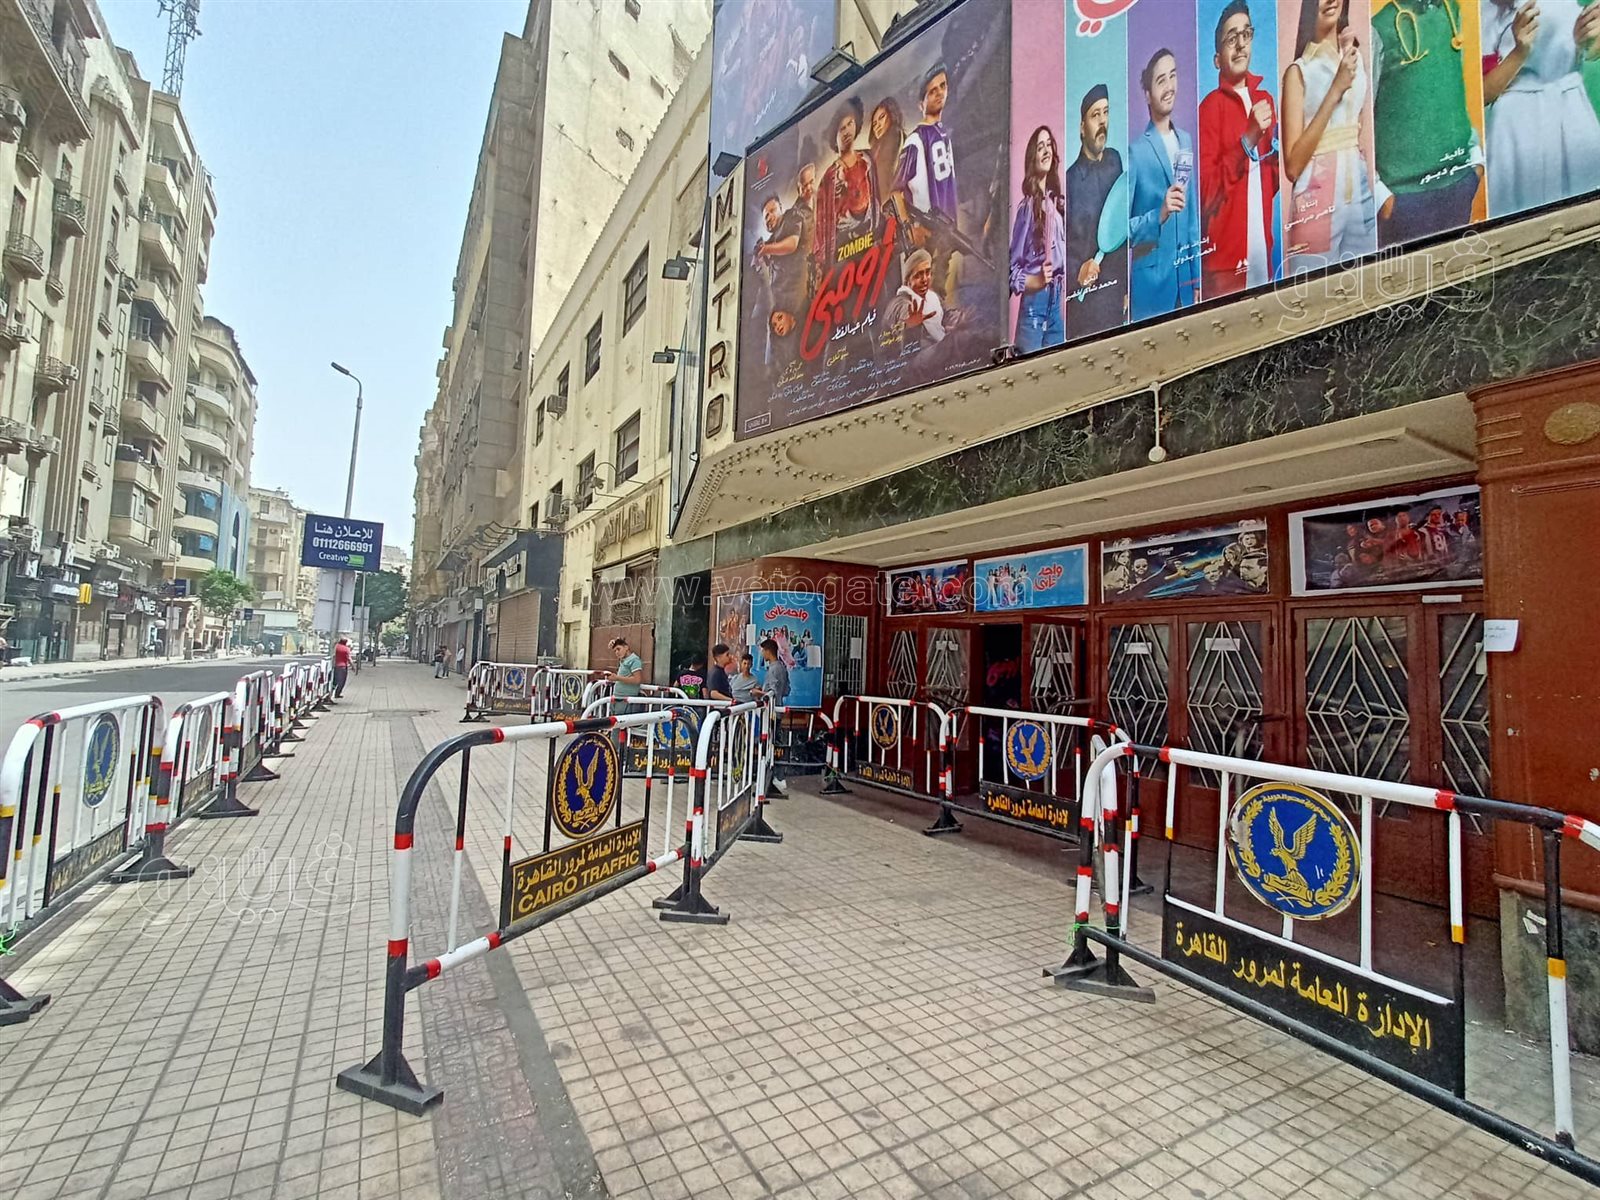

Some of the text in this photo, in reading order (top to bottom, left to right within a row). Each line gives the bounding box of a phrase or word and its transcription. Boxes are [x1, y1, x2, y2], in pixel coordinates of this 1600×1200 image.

[1419, 167, 1448, 186] دبور
[1284, 214, 1316, 231] مرسي
[837, 231, 874, 262] ZOMBIE
[1173, 254, 1195, 269] بدوي
[1098, 278, 1118, 290] محمد
[705, 176, 736, 440] METRO
[861, 308, 878, 332] فيلم
[314, 521, 374, 541] للإعلان هنا
[312, 536, 373, 553] 01112666991
[318, 551, 350, 562] Creative
[1038, 562, 1064, 577] واحد
[784, 607, 809, 622] واحد
[987, 790, 1011, 811] القاهرة
[1010, 799, 1027, 817] لمرور
[1026, 800, 1048, 819] العامة
[517, 828, 642, 893] الإدارة العامة لمرور القاهرة
[518, 850, 640, 913] CAIRO TRAFFIC
[1175, 919, 1229, 966] القاهرة
[1232, 957, 1286, 990] لمرور
[1290, 961, 1350, 1017] العامة
